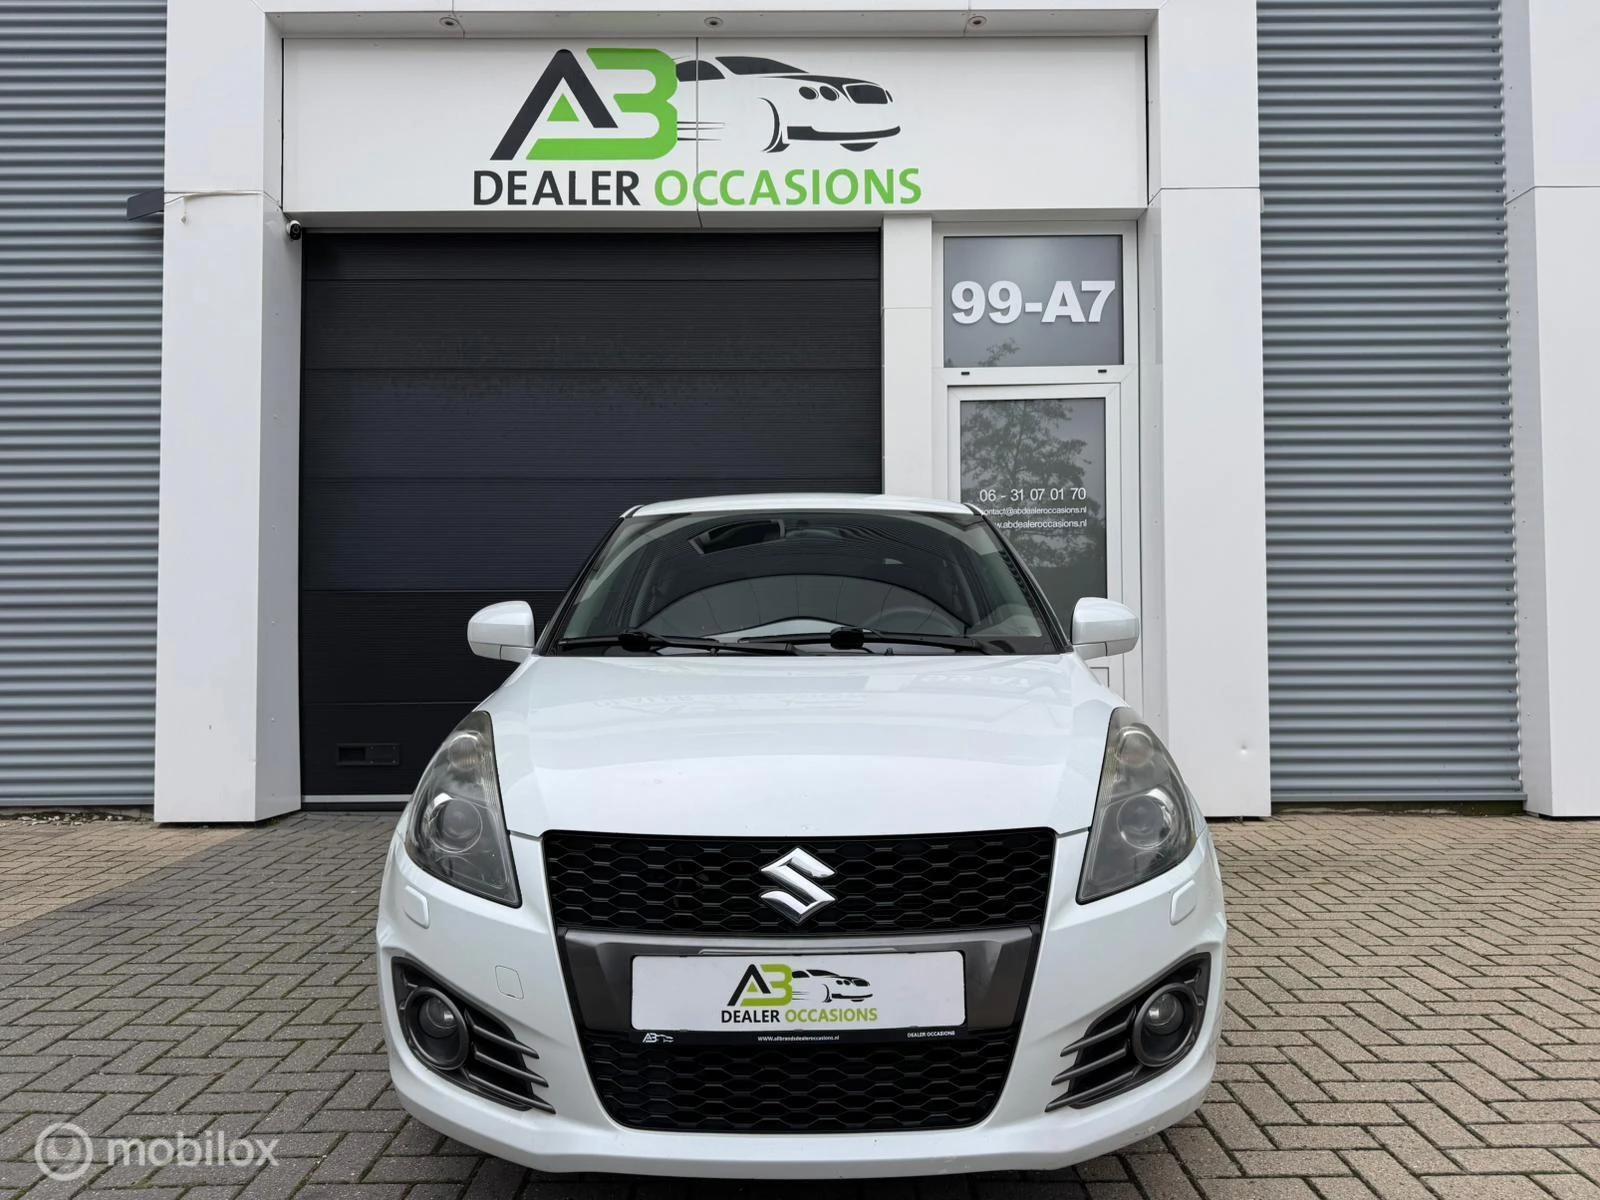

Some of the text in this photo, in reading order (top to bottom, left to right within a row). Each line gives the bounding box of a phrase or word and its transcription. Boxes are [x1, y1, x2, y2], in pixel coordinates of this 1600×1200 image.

[489, 47, 679, 161] AB
[473, 167, 922, 207] DEALER OCCASIONS
[950, 280, 1116, 325] 99-A7
[979, 489, 997, 502] 06
[1010, 488, 1024, 501] 31
[1029, 488, 1045, 501] 07
[1050, 488, 1064, 501] 01
[1070, 487, 1087, 500] 70
[982, 505, 1087, 516] ontact@abdealeroccasions.nl
[721, 1007, 878, 1024] DEALER OCCASIONS
